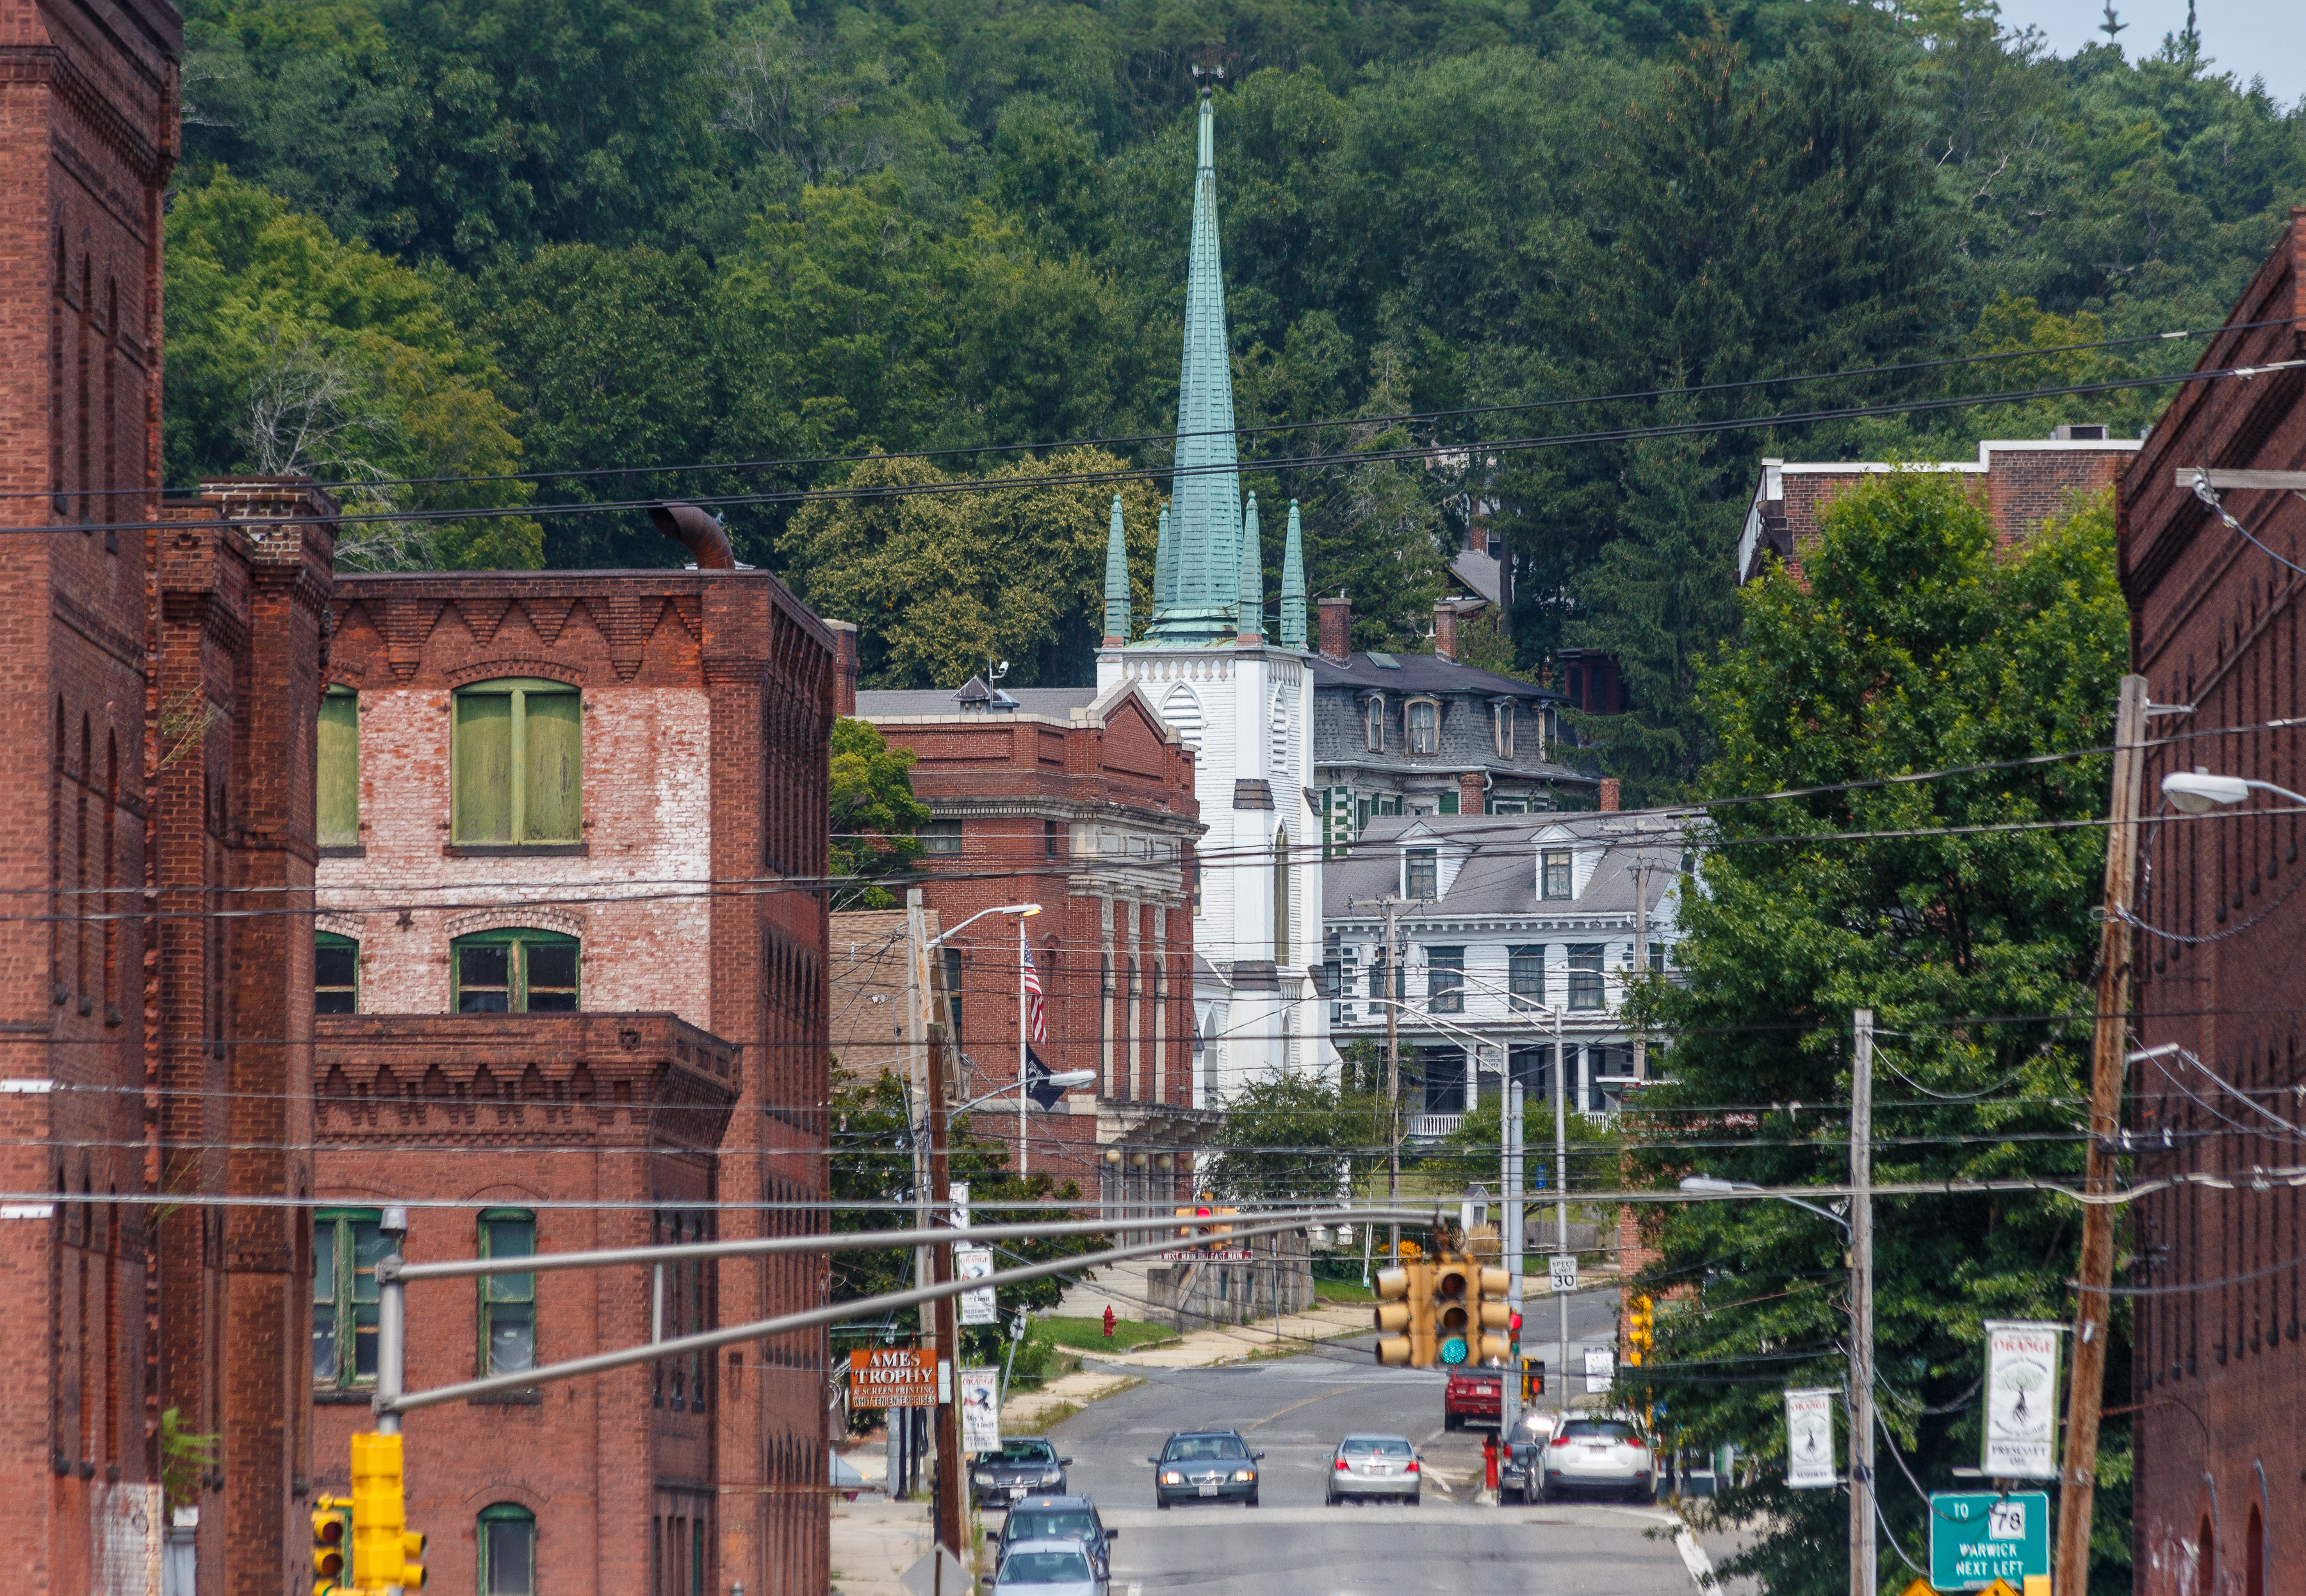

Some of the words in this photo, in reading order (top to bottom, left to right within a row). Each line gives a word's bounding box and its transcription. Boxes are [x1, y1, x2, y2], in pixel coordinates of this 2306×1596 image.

[1163, 1251, 1179, 1260] WEST
[1182, 1252, 1196, 1260] MAIN
[1211, 1251, 1225, 1260] EAST
[1228, 1251, 1243, 1260] MAIN
[1553, 1274, 1574, 1287] 30
[1993, 1340, 2052, 1353] ORANGE
[869, 1352, 921, 1367] AMES
[855, 1368, 933, 1384] TROPHY
[854, 1387, 859, 1395] &
[862, 1387, 894, 1395] SCREEN
[896, 1386, 934, 1394] PRINTING
[853, 1397, 886, 1406] WHITTEN
[887, 1396, 936, 1406] ENTERPRISES
[1954, 1502, 1968, 1519] TO
[1996, 1513, 2021, 1531] 78
[1959, 1542, 2017, 1558] WARWICK
[1956, 1560, 1988, 1577] NEXT
[1993, 1560, 2024, 1577] LEFT
